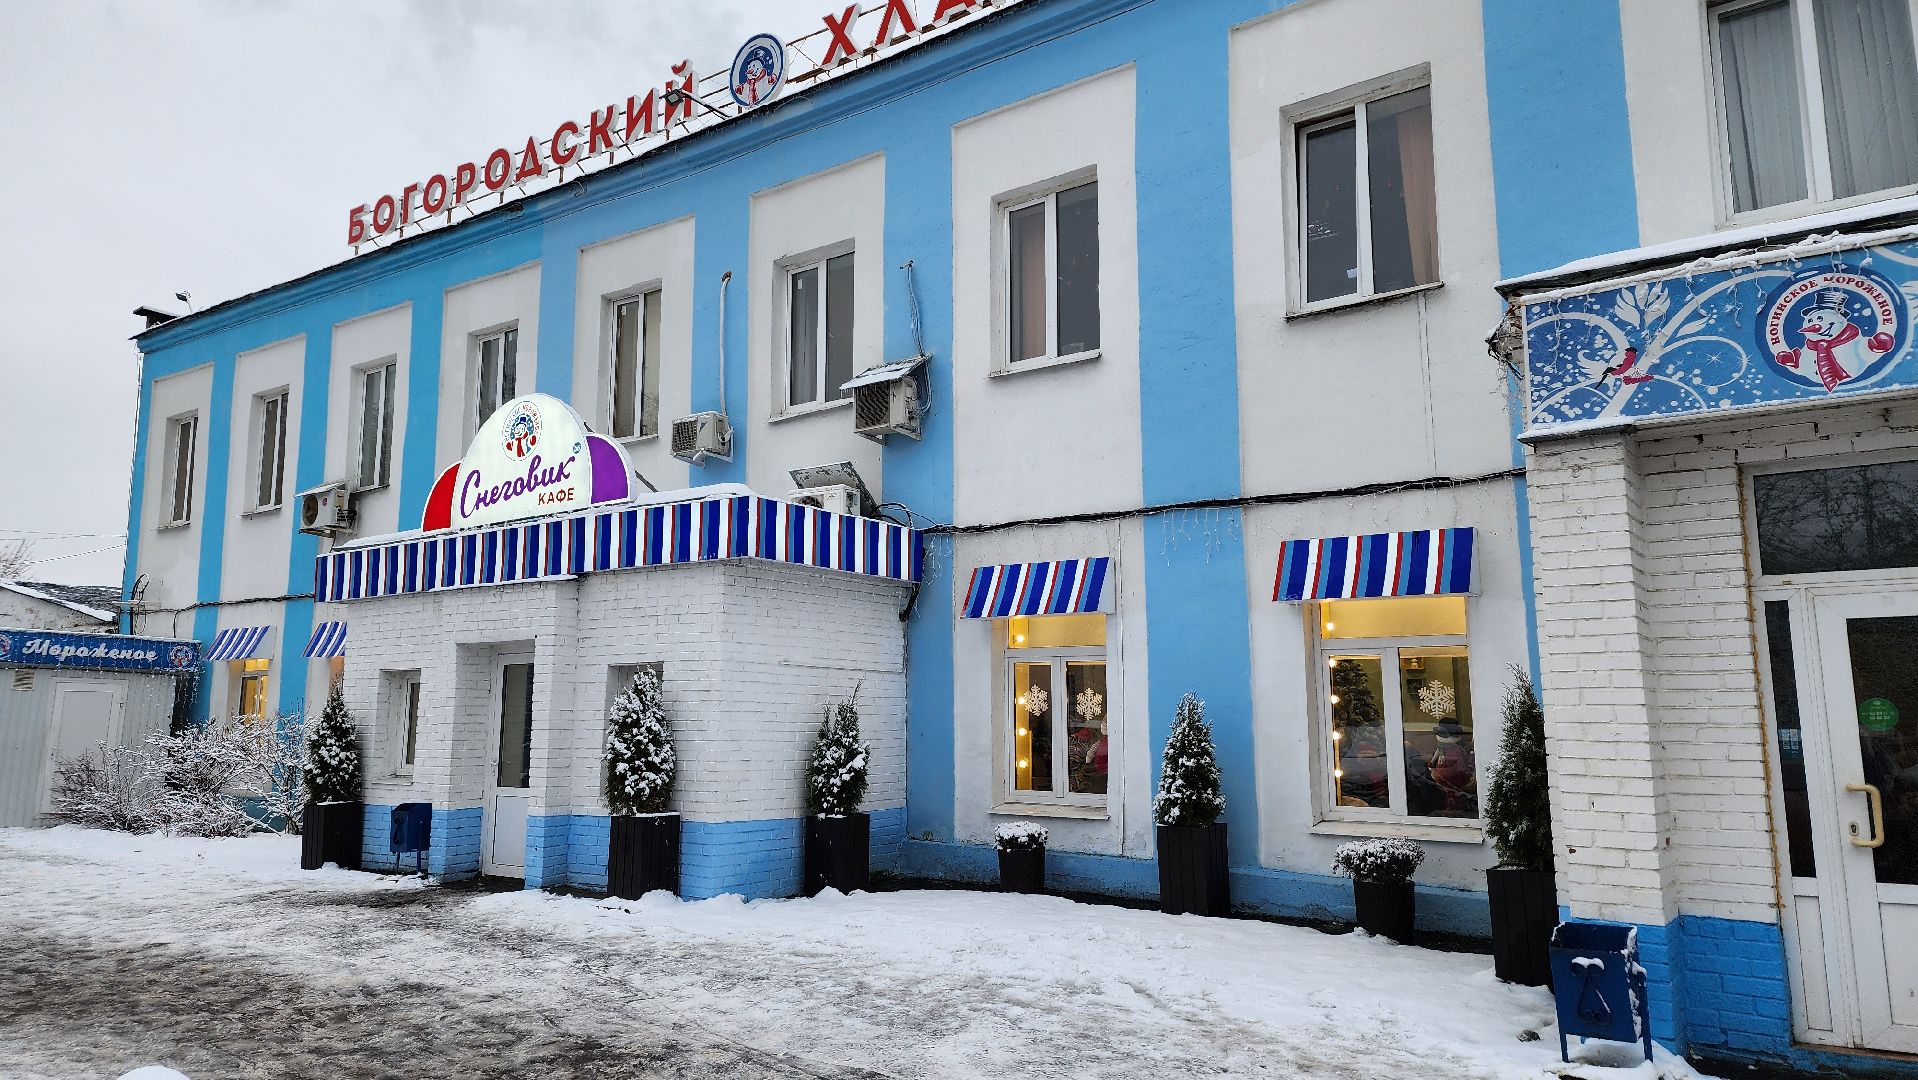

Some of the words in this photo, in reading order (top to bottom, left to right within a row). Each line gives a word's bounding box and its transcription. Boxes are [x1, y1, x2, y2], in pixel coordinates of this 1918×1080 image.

[347, 59, 700, 246] БОГОРОДСКИЙ
[1769, 279, 1819, 346] НОГИНСКОЕ
[460, 454, 576, 519] Снеговик
[537, 486, 575, 506] КАФЕ
[22, 638, 159, 662] Мороженое
